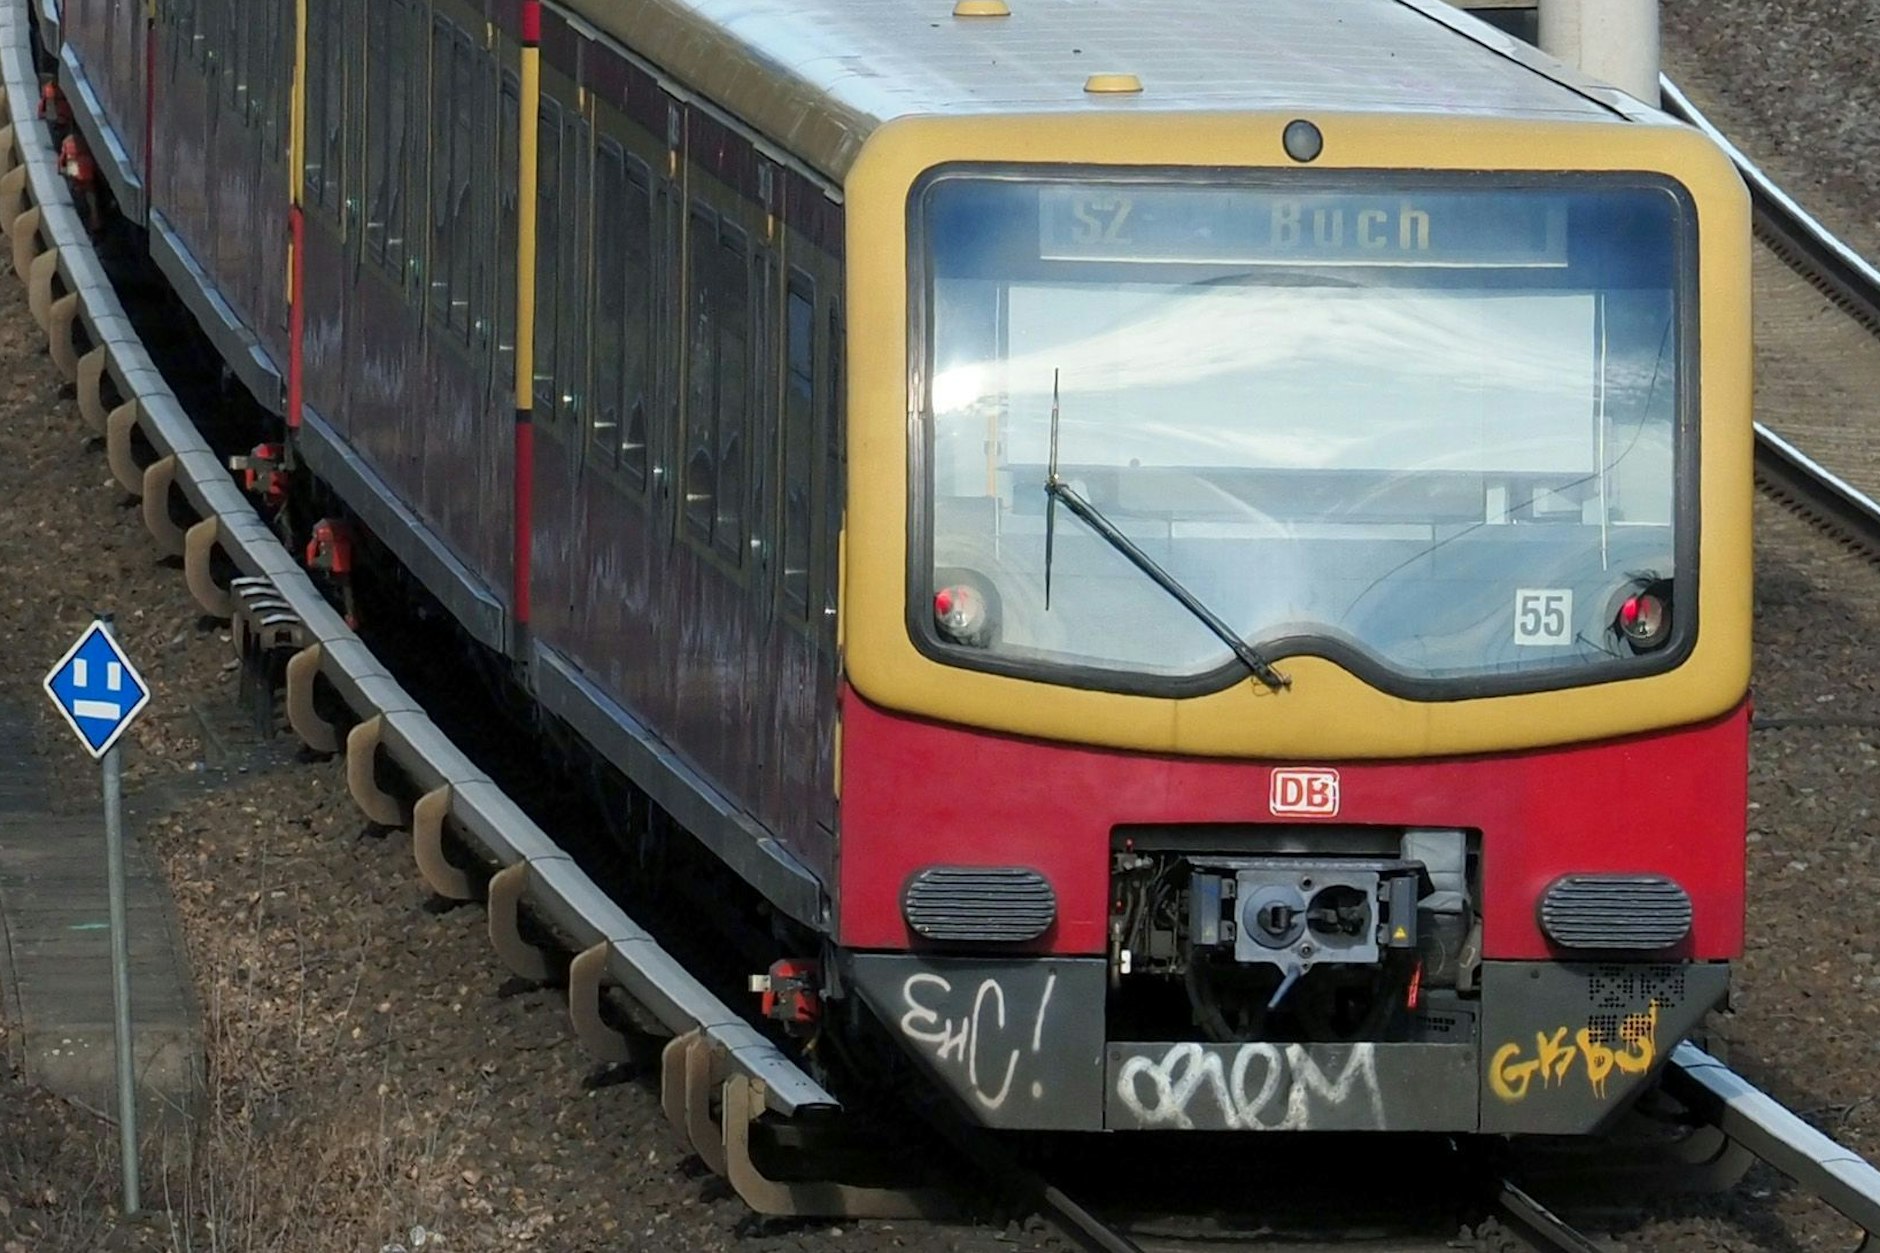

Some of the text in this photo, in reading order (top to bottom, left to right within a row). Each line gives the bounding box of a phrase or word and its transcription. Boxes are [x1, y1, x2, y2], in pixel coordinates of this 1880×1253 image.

[1071, 198, 1430, 251] S2 Buch
[1519, 595, 1565, 637] 55
[1280, 777, 1329, 807] DB
